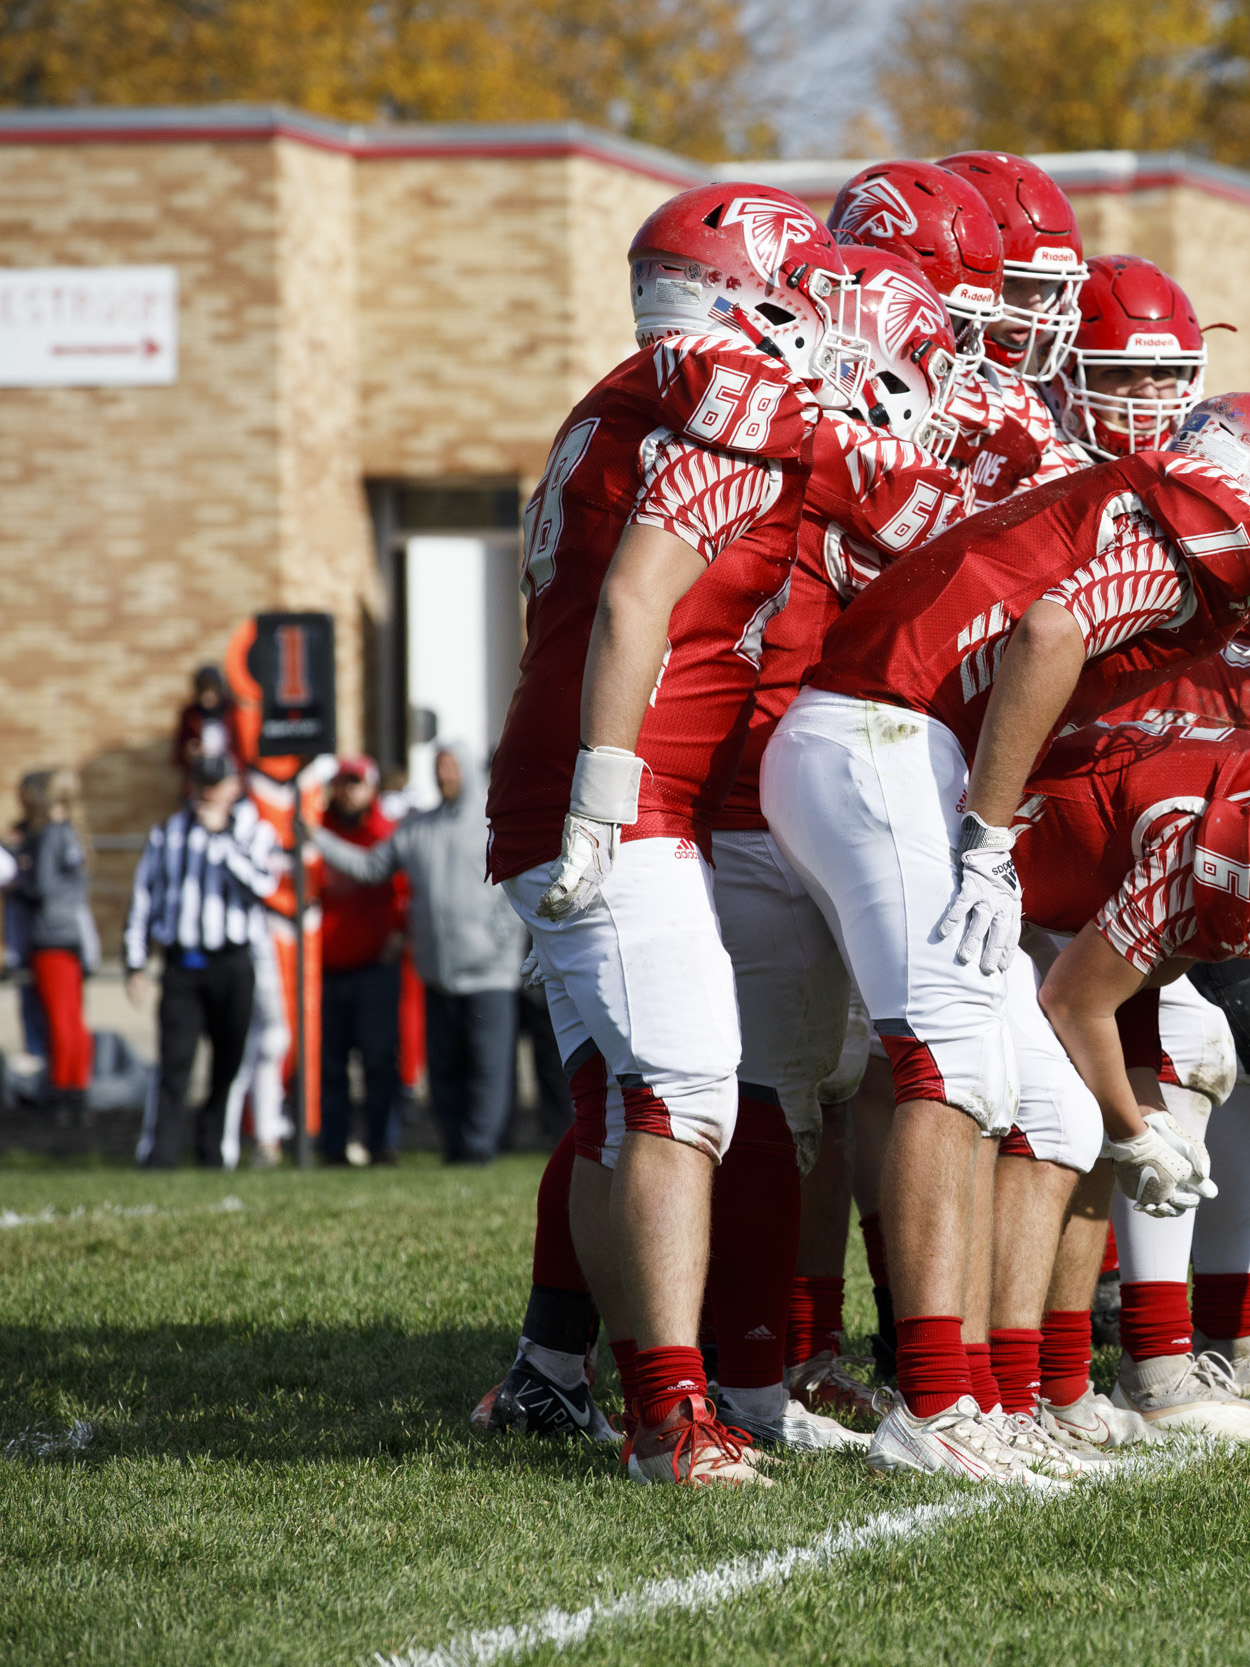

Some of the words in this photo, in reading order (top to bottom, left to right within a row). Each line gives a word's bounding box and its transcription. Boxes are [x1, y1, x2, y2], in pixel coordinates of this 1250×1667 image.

[1042, 251, 1074, 262] Riddell
[960, 288, 993, 303] Riddell
[683, 363, 788, 452] 68
[274, 624, 314, 708] 1
